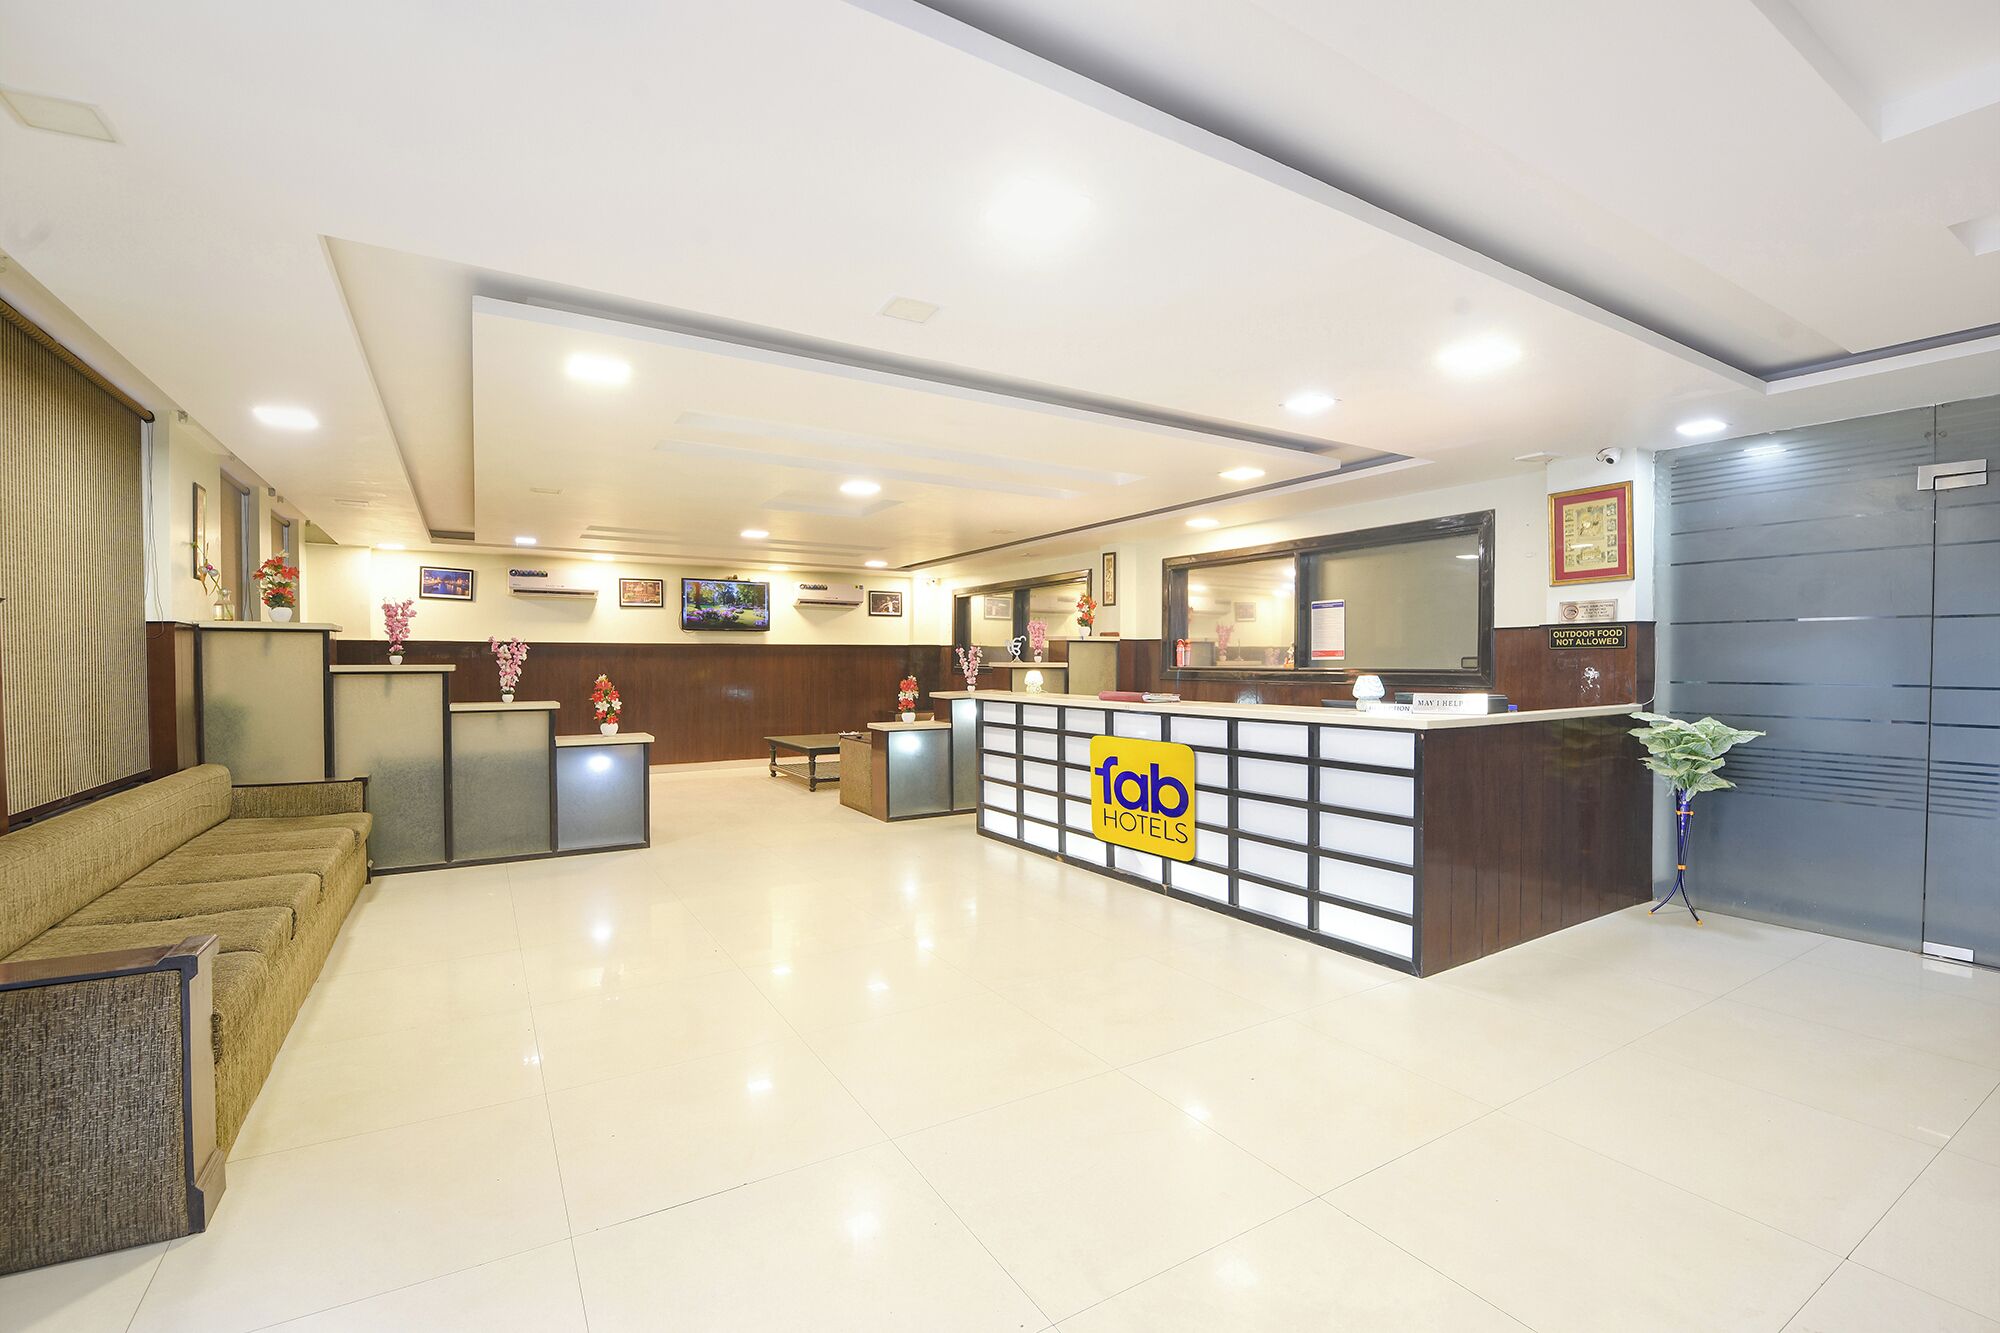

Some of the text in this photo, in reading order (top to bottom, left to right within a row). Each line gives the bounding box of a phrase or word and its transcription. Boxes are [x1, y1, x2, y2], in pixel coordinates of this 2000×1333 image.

[1553, 629, 1623, 638] OUTDOOR FOOD
[1556, 638, 1574, 646] NOT
[1095, 756, 1189, 818] fab
[1104, 808, 1188, 844] HOTELS
